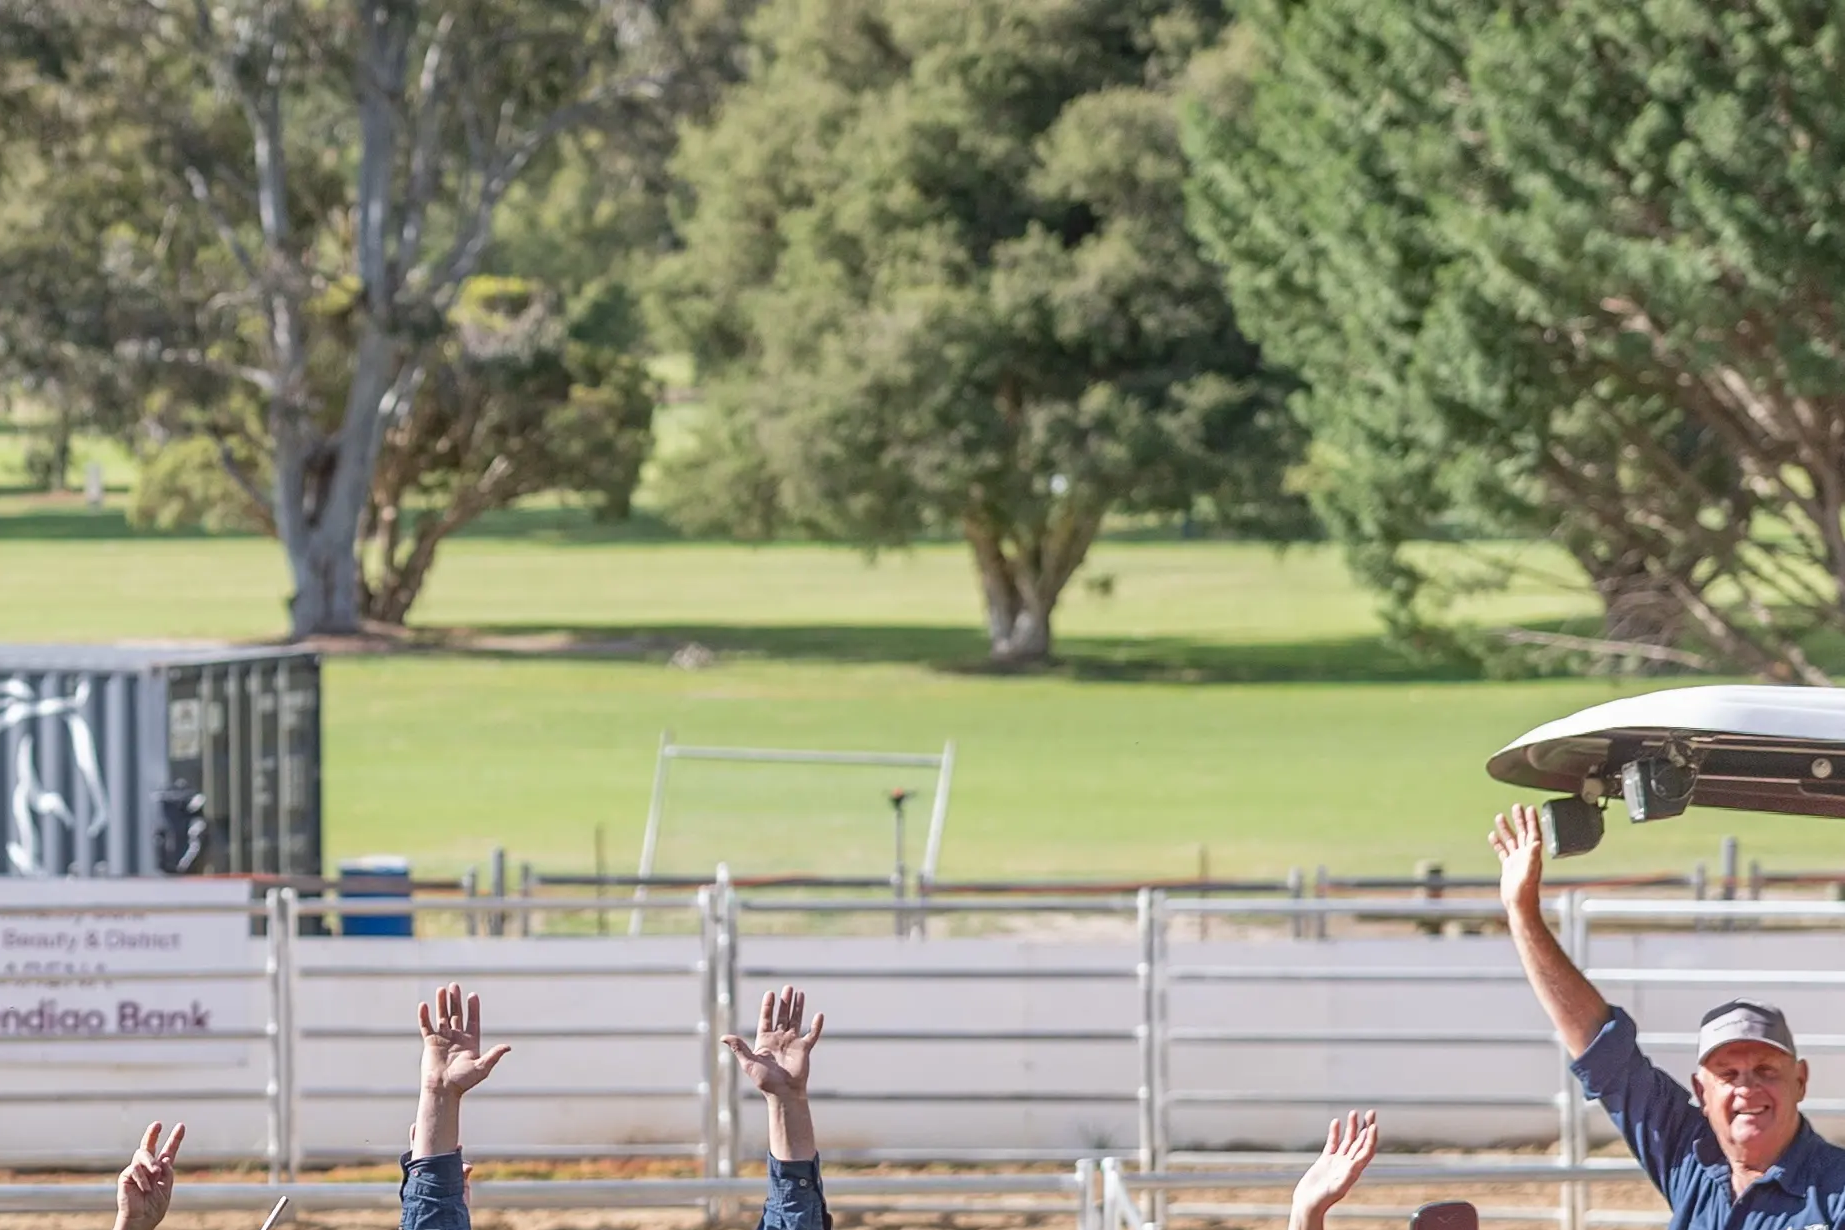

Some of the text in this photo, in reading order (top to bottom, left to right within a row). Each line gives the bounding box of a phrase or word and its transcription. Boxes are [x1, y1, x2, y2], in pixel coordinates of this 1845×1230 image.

[1, 927, 76, 953] Beauty
[84, 929, 99, 950] &
[104, 928, 181, 950] District
[118, 999, 210, 1033] Bank
